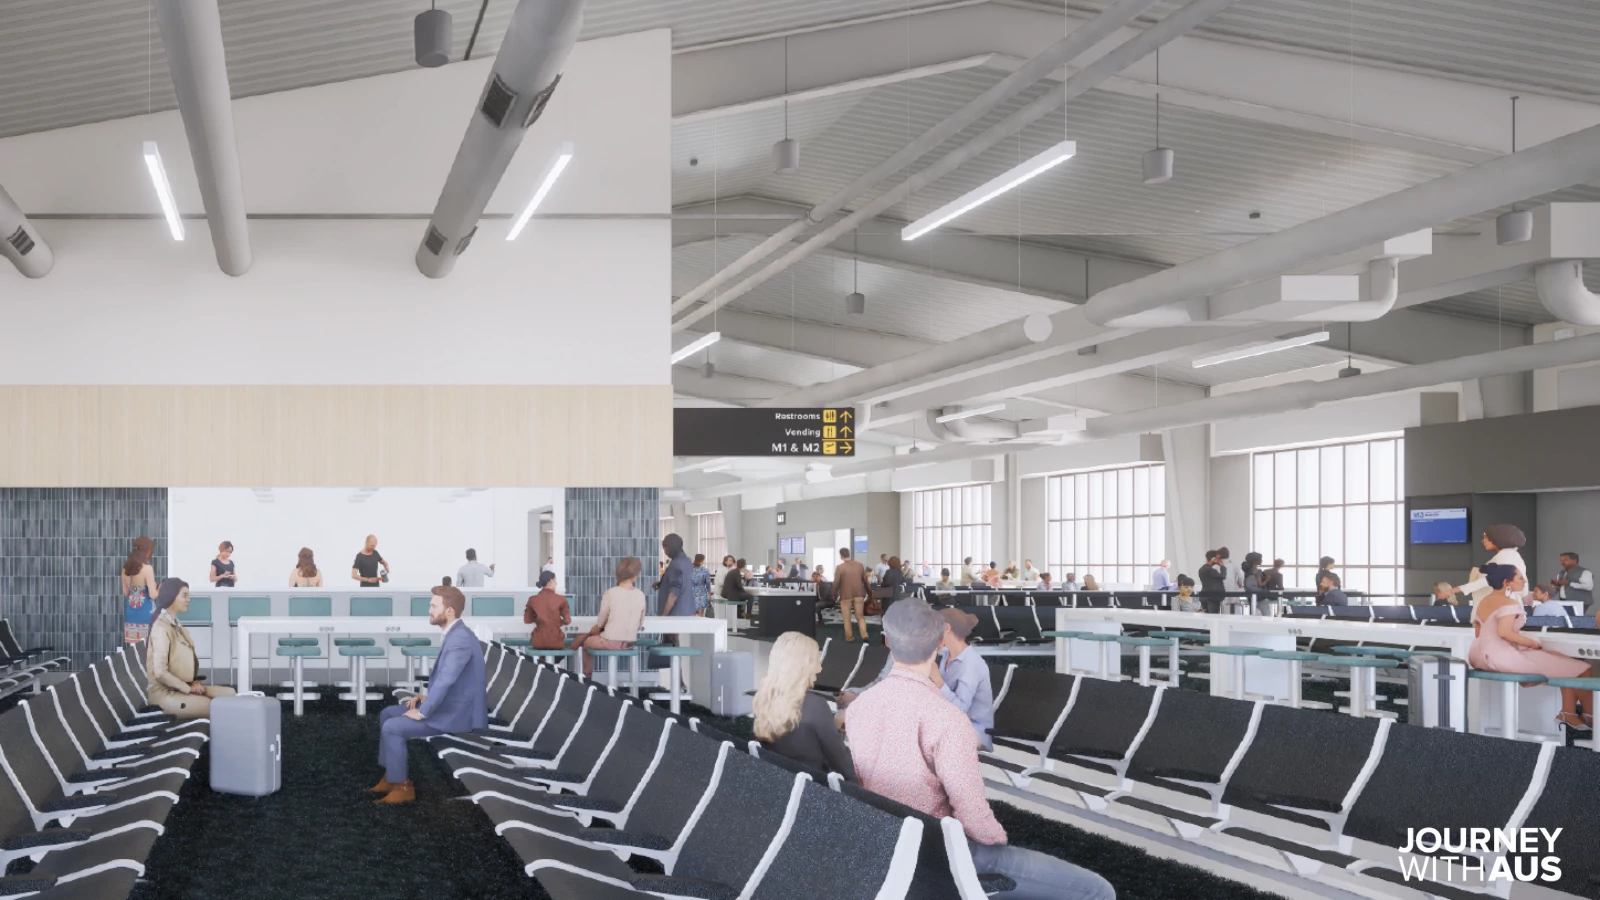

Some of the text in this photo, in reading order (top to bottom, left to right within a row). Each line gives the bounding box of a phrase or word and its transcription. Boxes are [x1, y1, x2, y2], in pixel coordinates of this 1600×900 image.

[775, 412, 821, 420] Restrooms
[785, 428, 821, 437] Vending
[771, 442, 820, 452] M1 & M2
